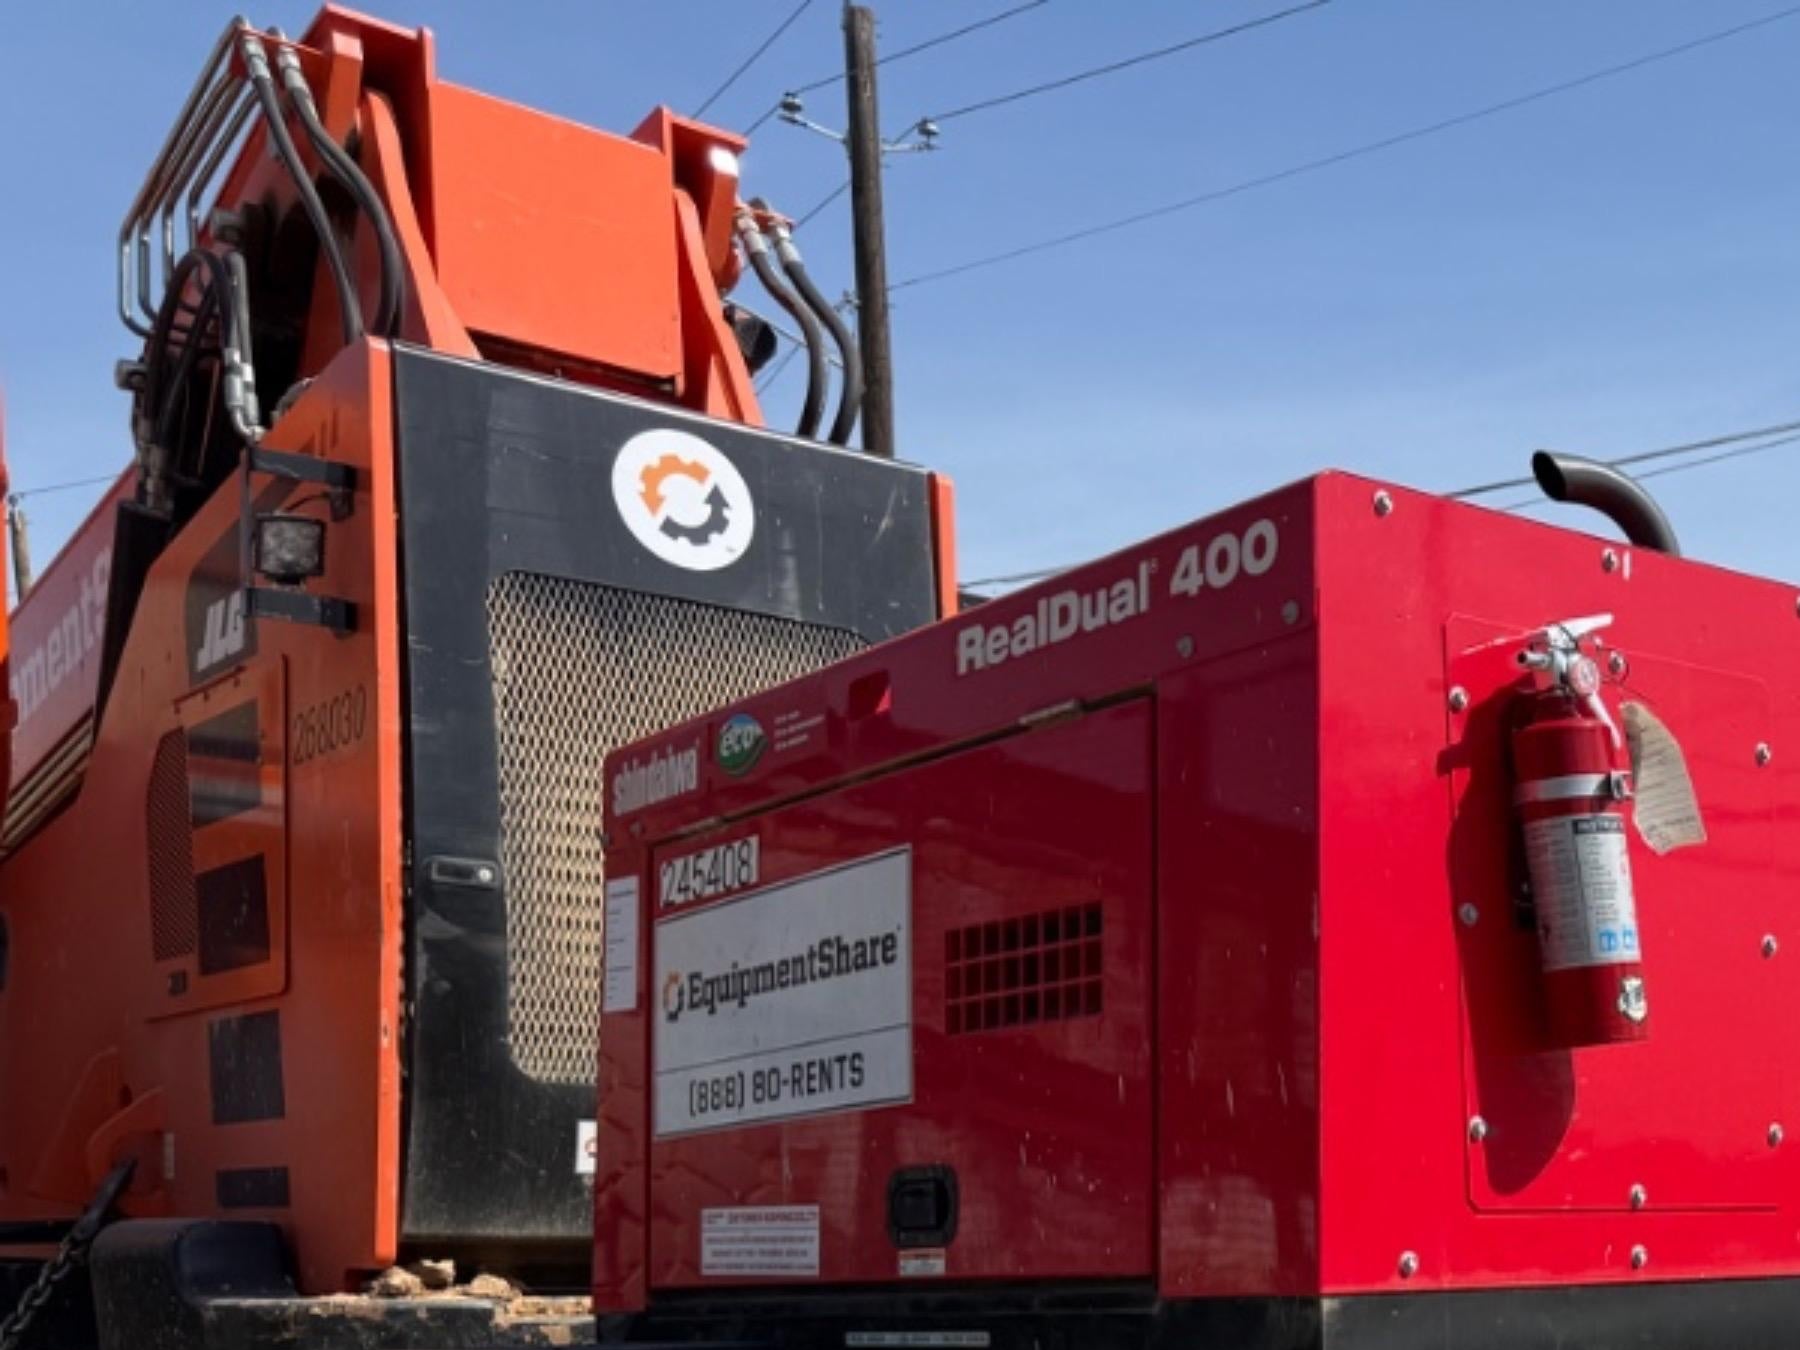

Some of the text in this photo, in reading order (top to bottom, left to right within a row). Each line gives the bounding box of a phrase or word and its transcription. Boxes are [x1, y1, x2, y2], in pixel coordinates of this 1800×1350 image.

[196, 589, 245, 672] JLG
[956, 517, 1279, 676] RealDual 400
[293, 683, 367, 766] 268030
[662, 841, 754, 907] 245408
[686, 931, 898, 1016] EquipmentShare
[689, 1071, 744, 1118] (888)
